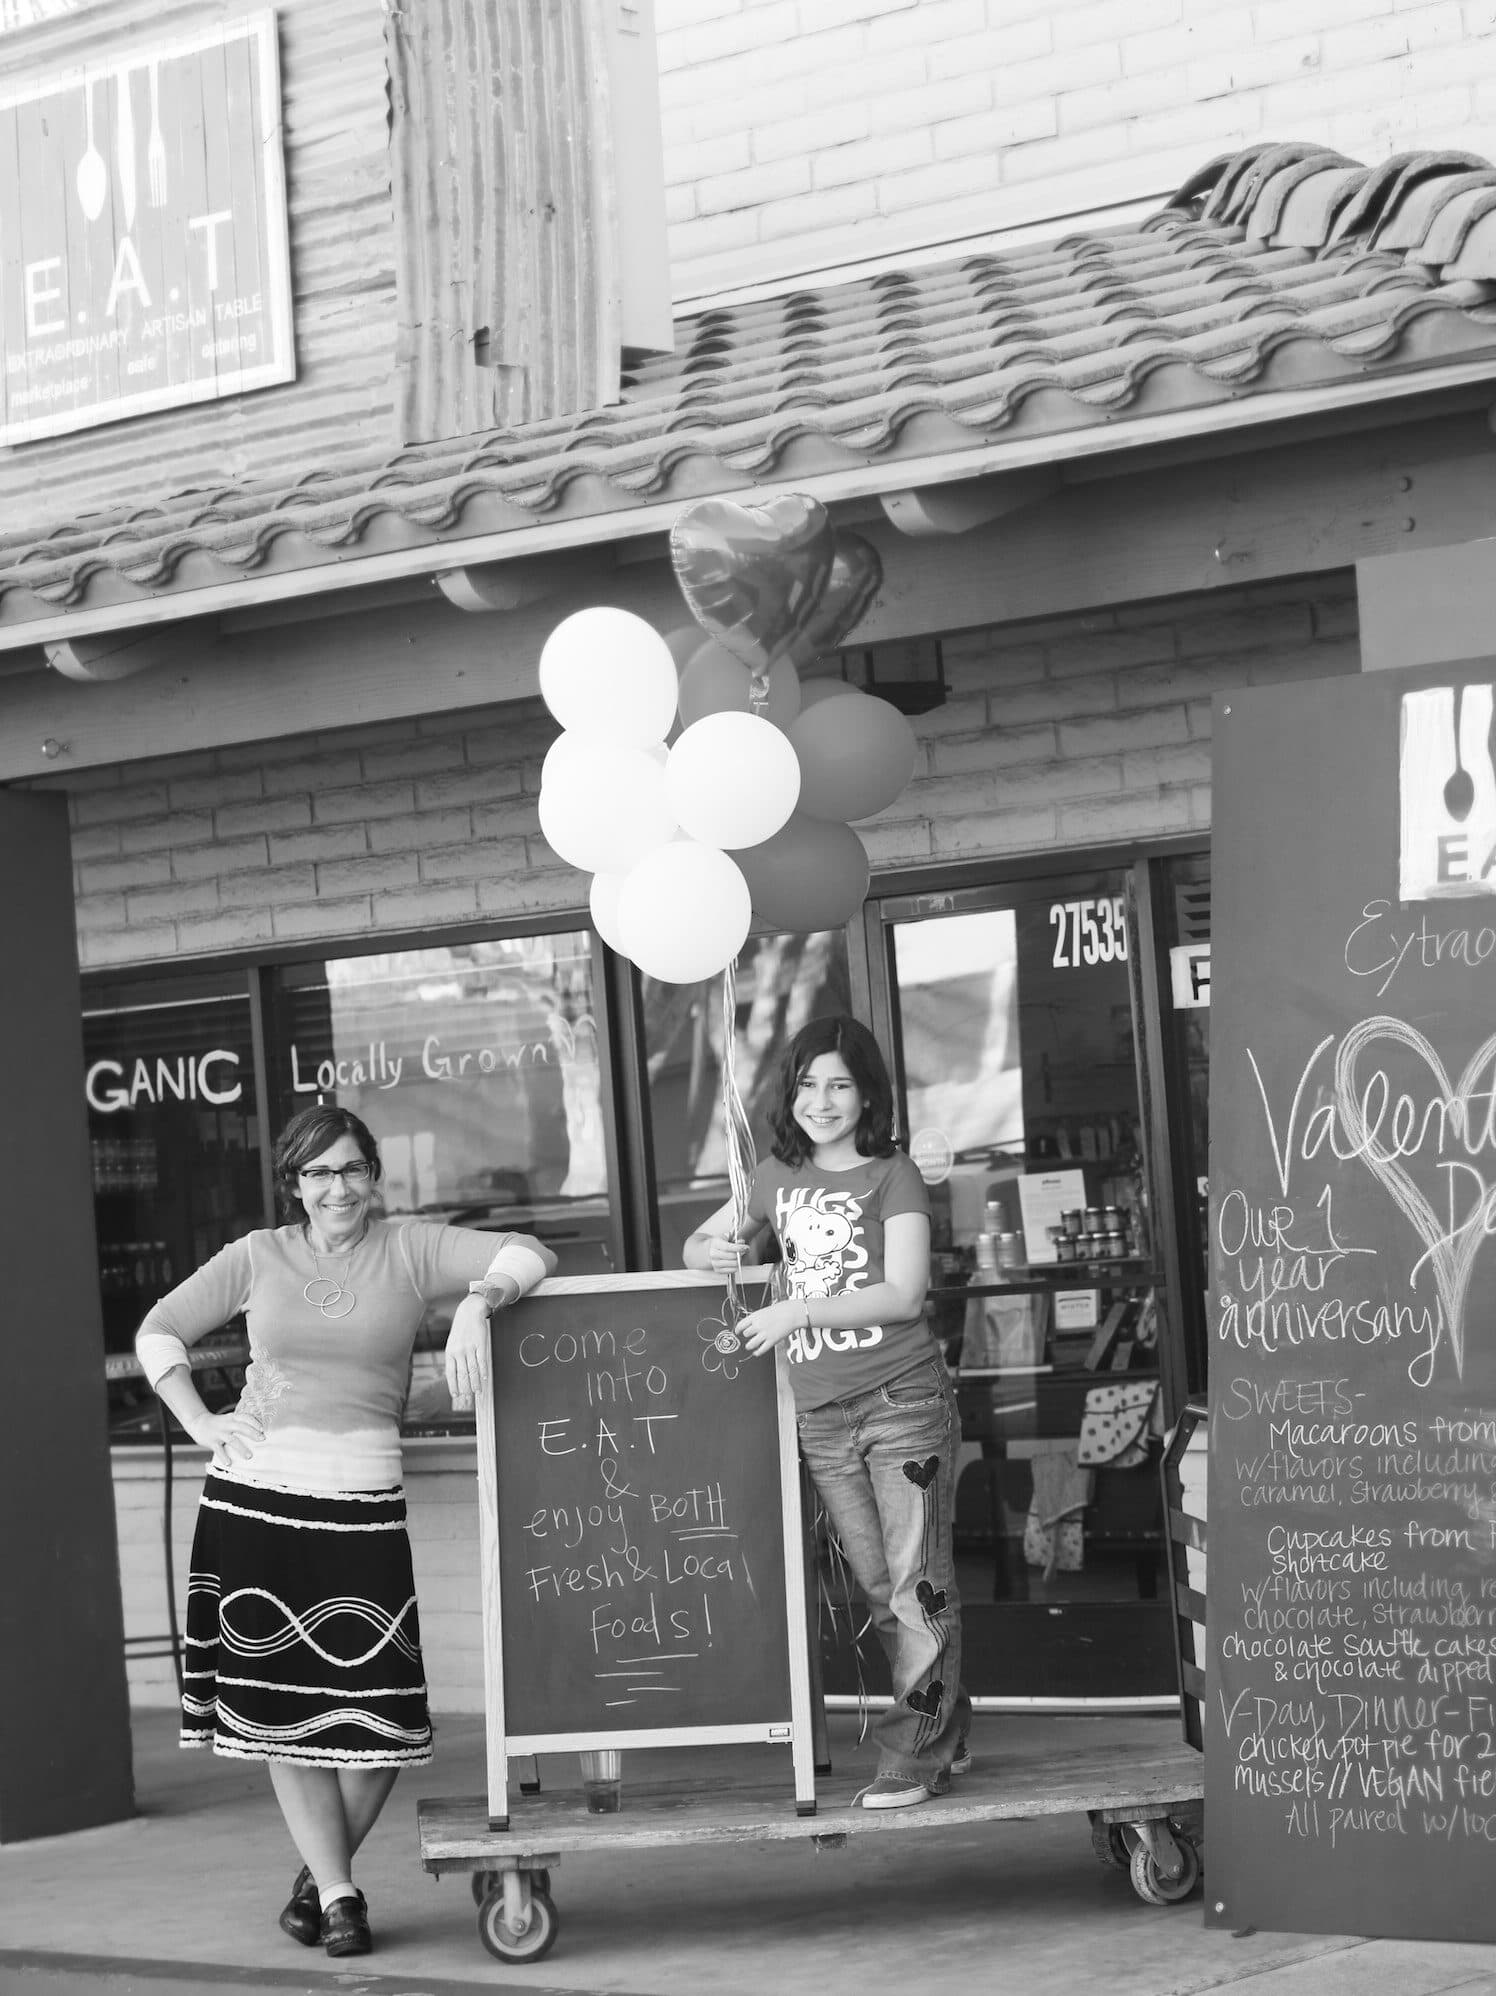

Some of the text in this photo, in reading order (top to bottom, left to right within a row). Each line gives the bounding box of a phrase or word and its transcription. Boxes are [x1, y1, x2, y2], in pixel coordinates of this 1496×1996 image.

[141, 307, 206, 340] ARTISAN
[215, 293, 263, 322] TABLE
[1050, 898, 1128, 968] 27535
[85, 1049, 242, 1113] GANIC
[291, 1035, 550, 1092] Locally Grown
[1239, 1255, 1345, 1314] year
[586, 1358, 668, 1406] into
[1270, 1416, 1496, 1458] Macaroons from
[600, 1458, 639, 1499] &
[523, 1503, 628, 1553] enjoy
[1268, 1524, 1391, 1560] Cupcakes
[1404, 1520, 1476, 1550] from
[525, 1554, 625, 1602] Fresh
[1364, 1571, 1471, 1607] including
[1222, 1631, 1333, 1661] chocolate
[1418, 1655, 1494, 1693] dipped
[1239, 1732, 1332, 1765] chicken
[1382, 1734, 1416, 1769] pie
[1424, 1729, 1471, 1760] for
[1285, 1800, 1320, 1838] All
[1329, 1799, 1409, 1848] paired
